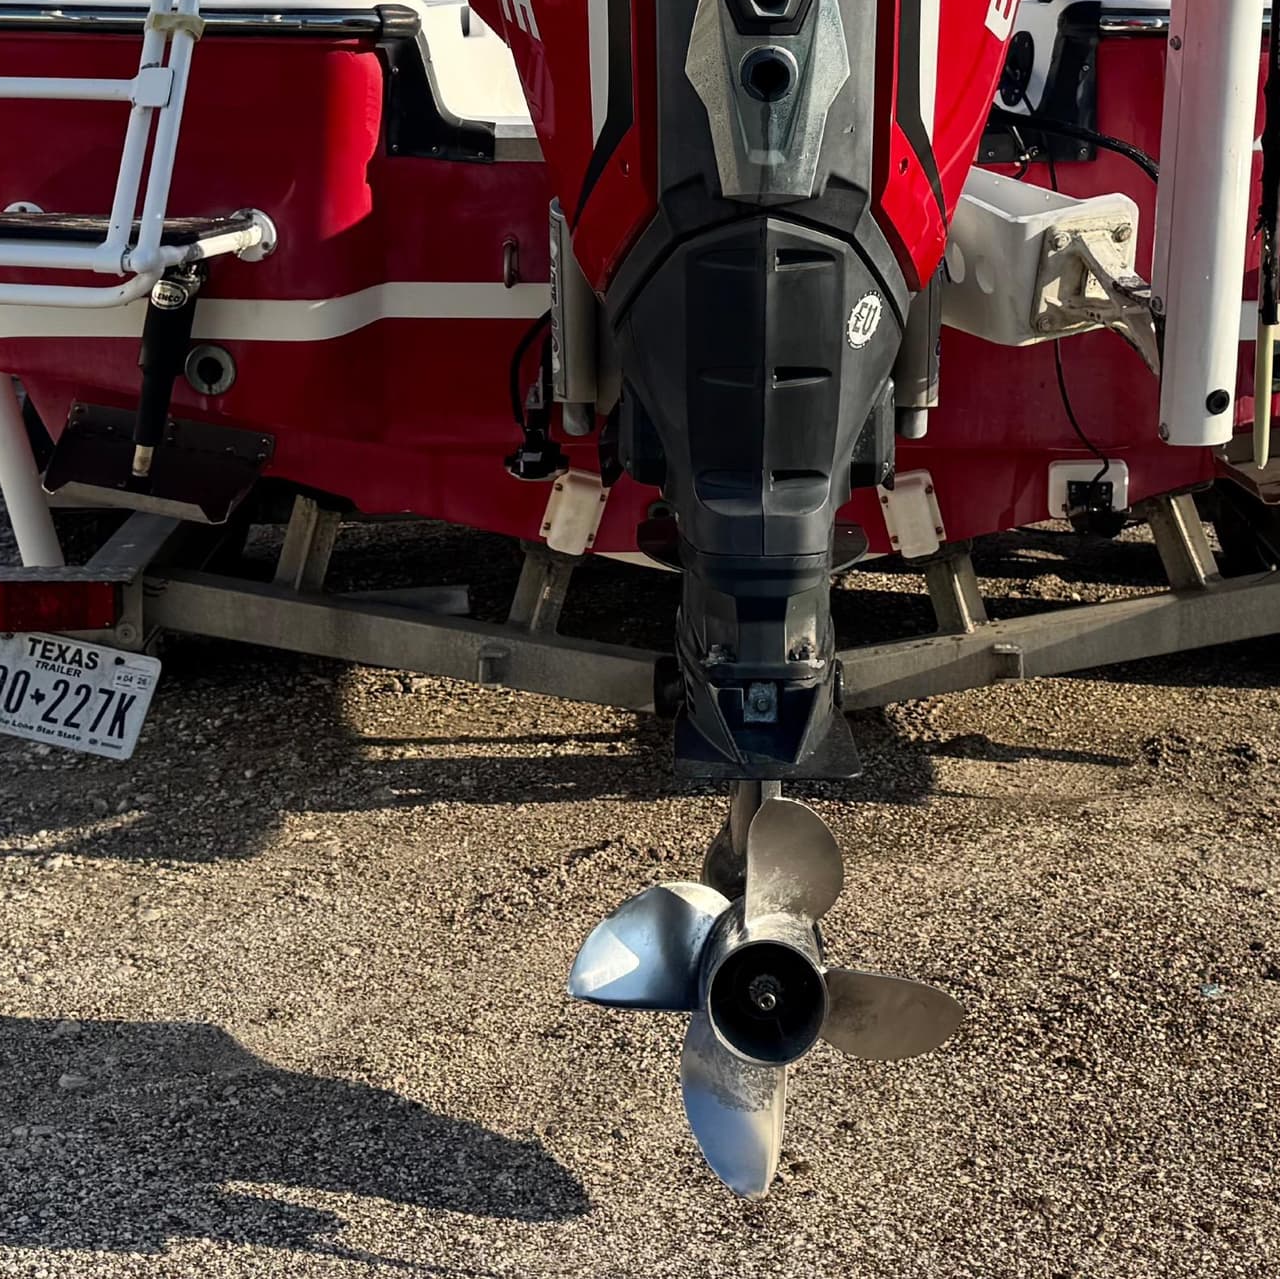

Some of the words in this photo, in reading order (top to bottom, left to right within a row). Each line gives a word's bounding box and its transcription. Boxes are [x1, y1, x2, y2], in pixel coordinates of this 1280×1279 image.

[27, 637, 99, 670] TEXAS
[35, 660, 82, 678] TRAILER
[41, 679, 136, 740] 227K
[12, 720, 34, 730] Lone
[36, 725, 55, 735] Star
[57, 730, 82, 741] State
